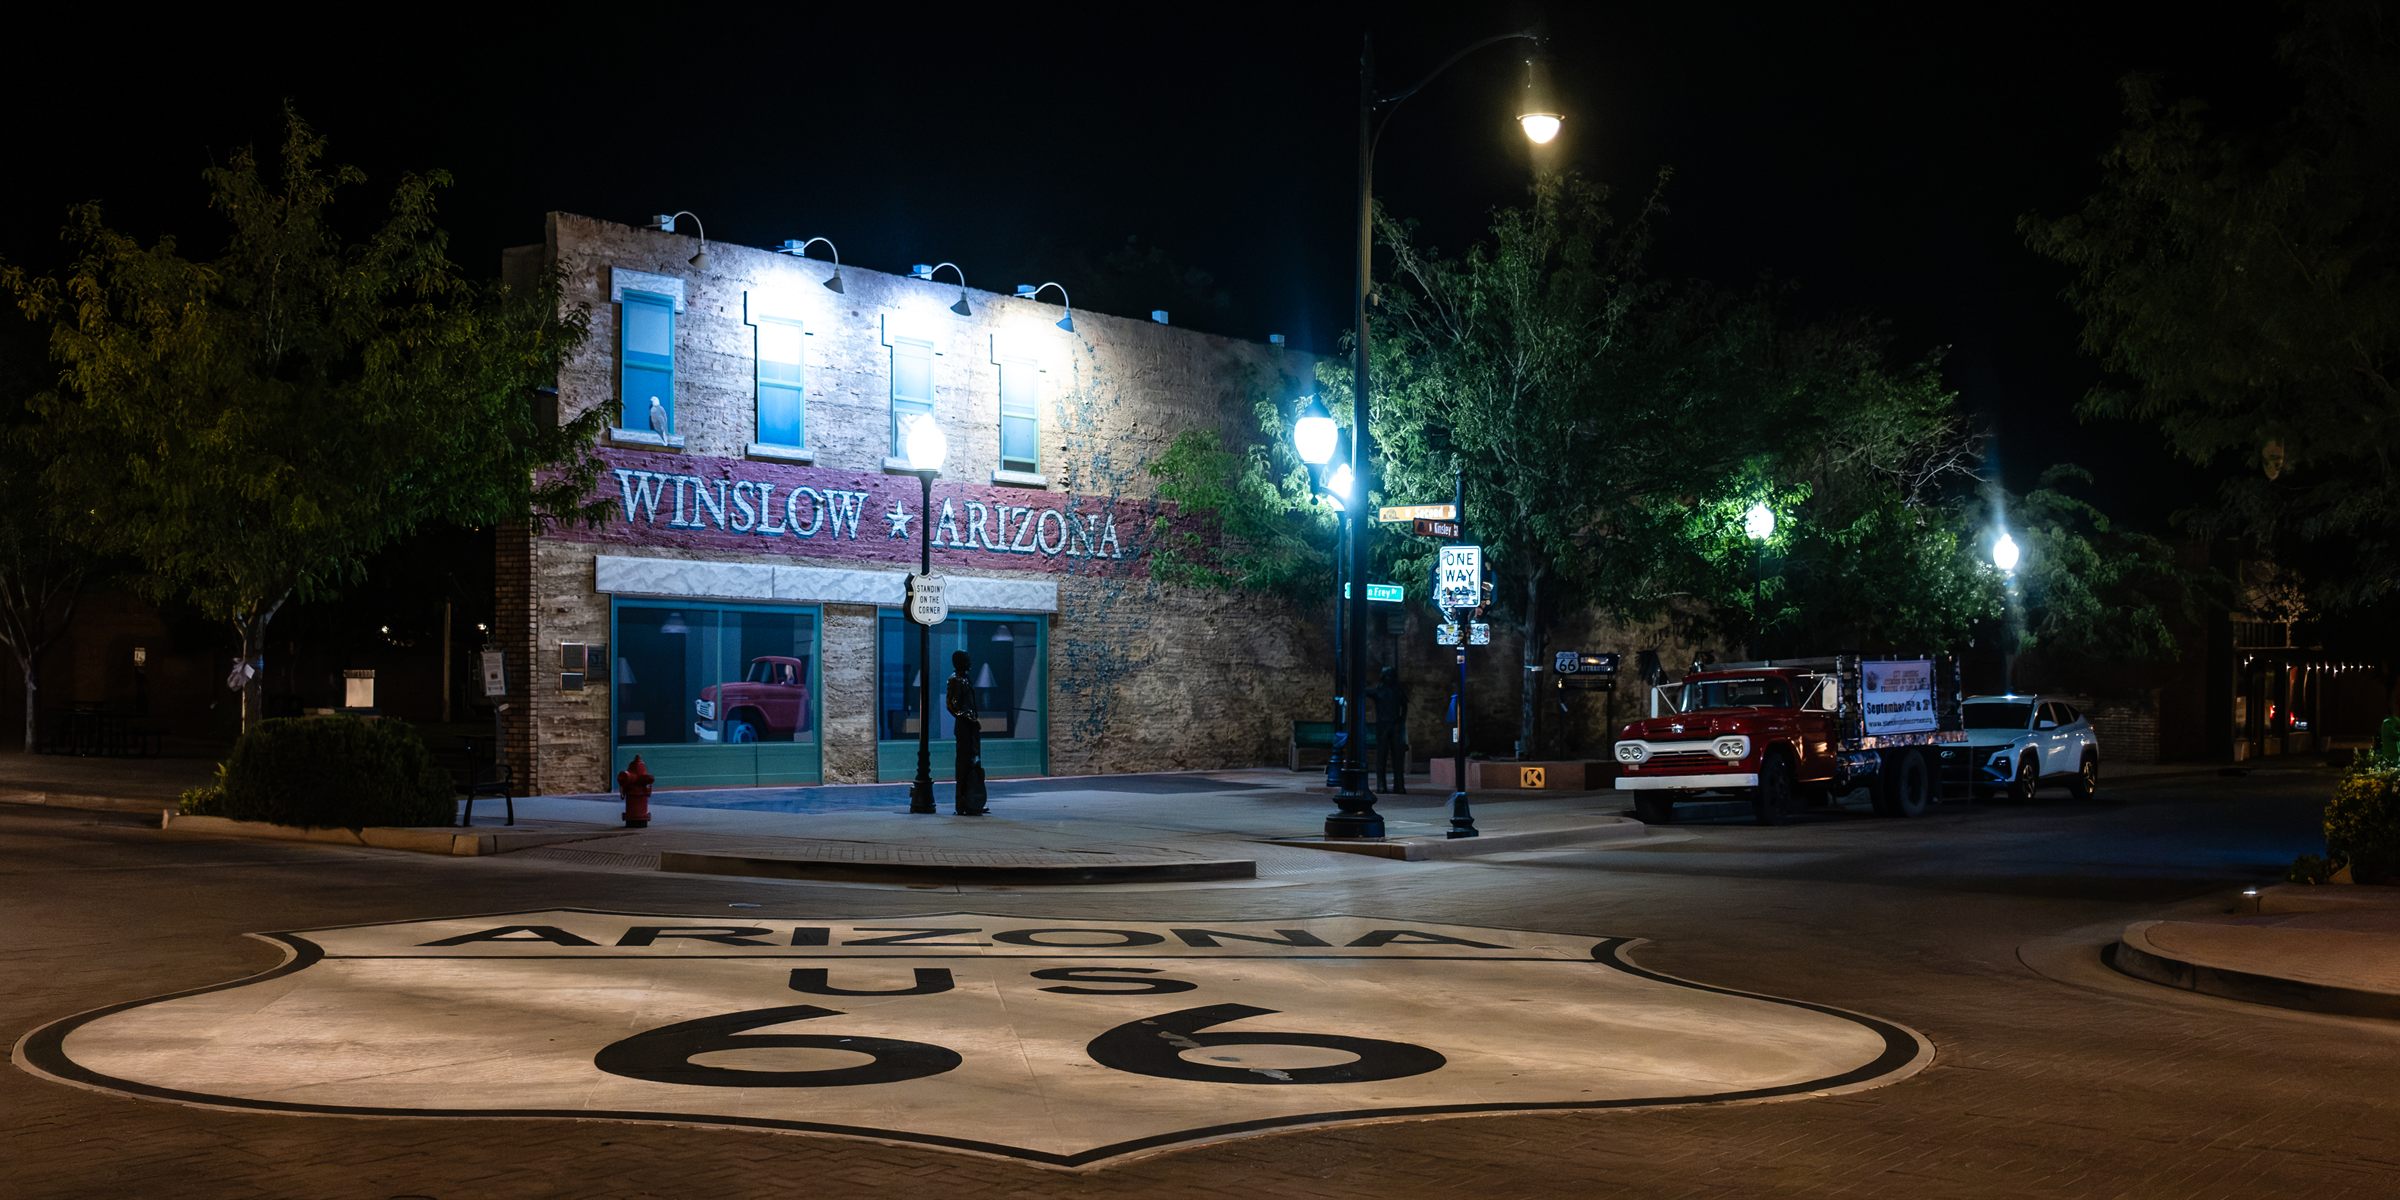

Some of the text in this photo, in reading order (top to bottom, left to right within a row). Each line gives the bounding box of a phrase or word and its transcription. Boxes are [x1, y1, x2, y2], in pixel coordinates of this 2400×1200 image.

[612, 467, 1122, 559] WINSLOW ARIZONA
[1434, 522, 1452, 537] Kinsley
[1447, 552, 1474, 566] ONE
[1445, 569, 1474, 582] WAY
[919, 595, 940, 604] ON THE
[1374, 587, 1391, 599] Frey
[918, 606, 941, 615] CORNER
[1559, 659, 1576, 672] 66
[413, 925, 1515, 949] ARIZONA
[594, 1003, 1447, 1087] 66
